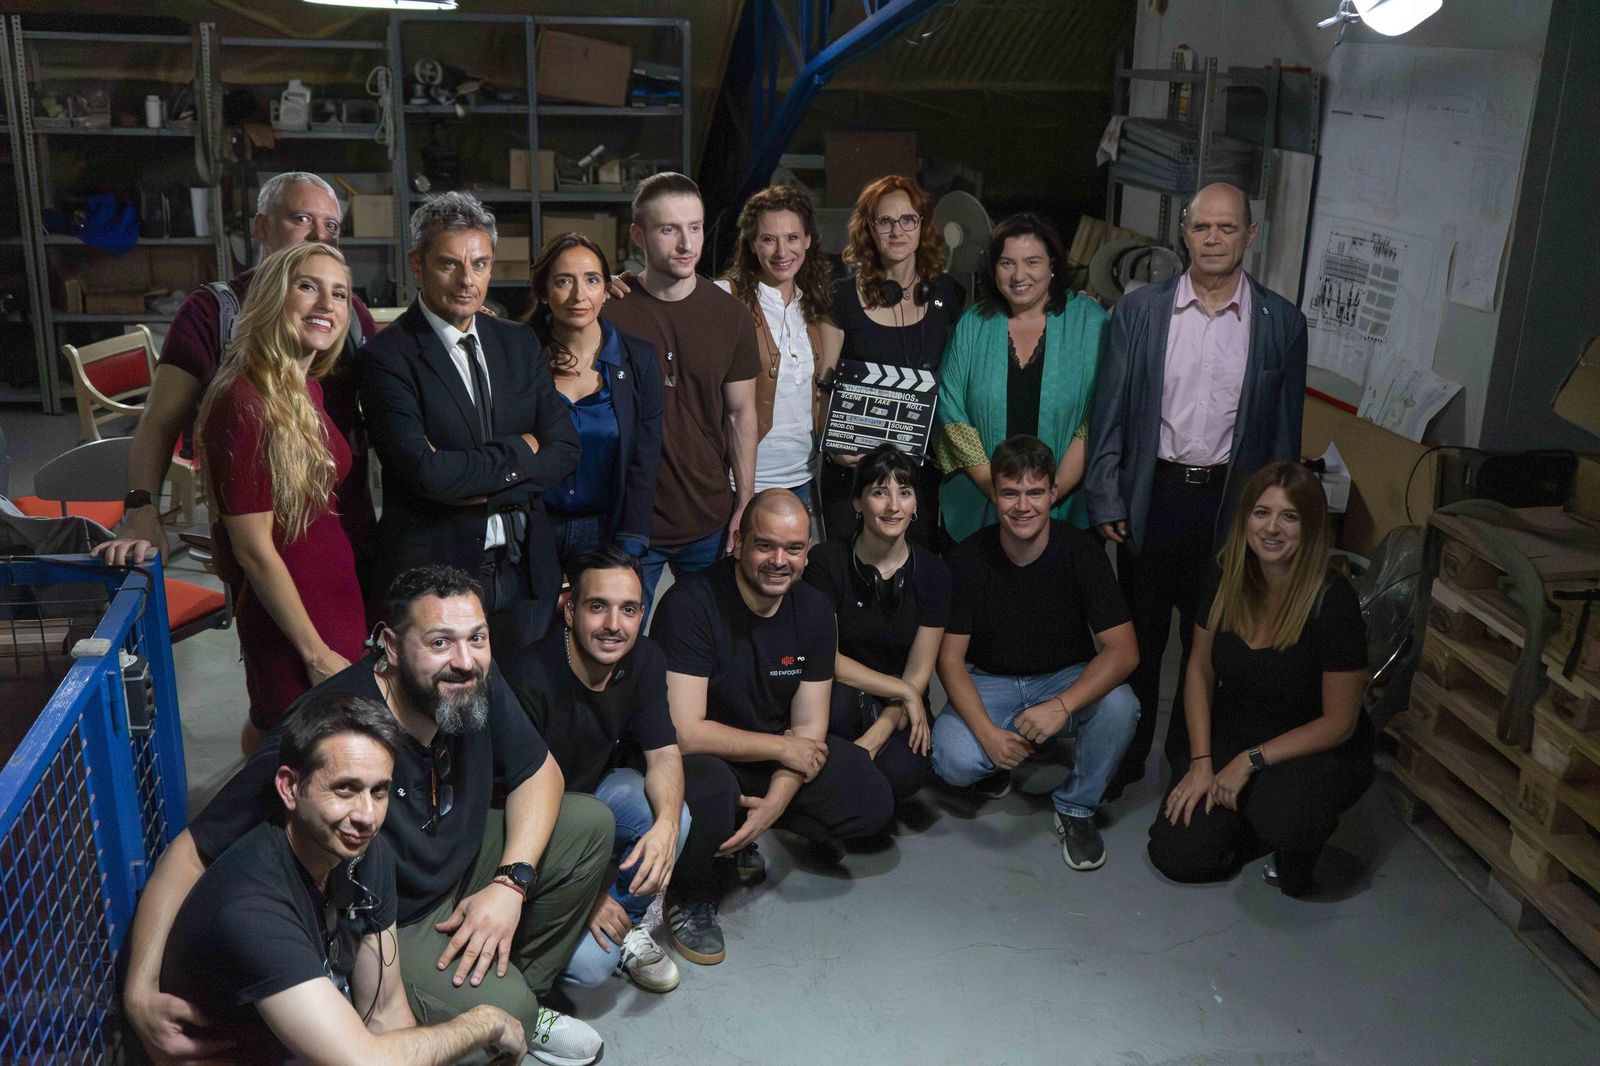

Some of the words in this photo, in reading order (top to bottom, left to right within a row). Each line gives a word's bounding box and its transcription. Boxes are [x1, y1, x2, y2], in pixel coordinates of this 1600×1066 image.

[840, 392, 862, 402] SCENE
[874, 398, 891, 406] TAKE
[906, 403, 923, 411] ROLL
[890, 422, 914, 431] SOUND
[828, 431, 854, 440] DIRECTOR
[826, 441, 858, 452] CAMERAMAN
